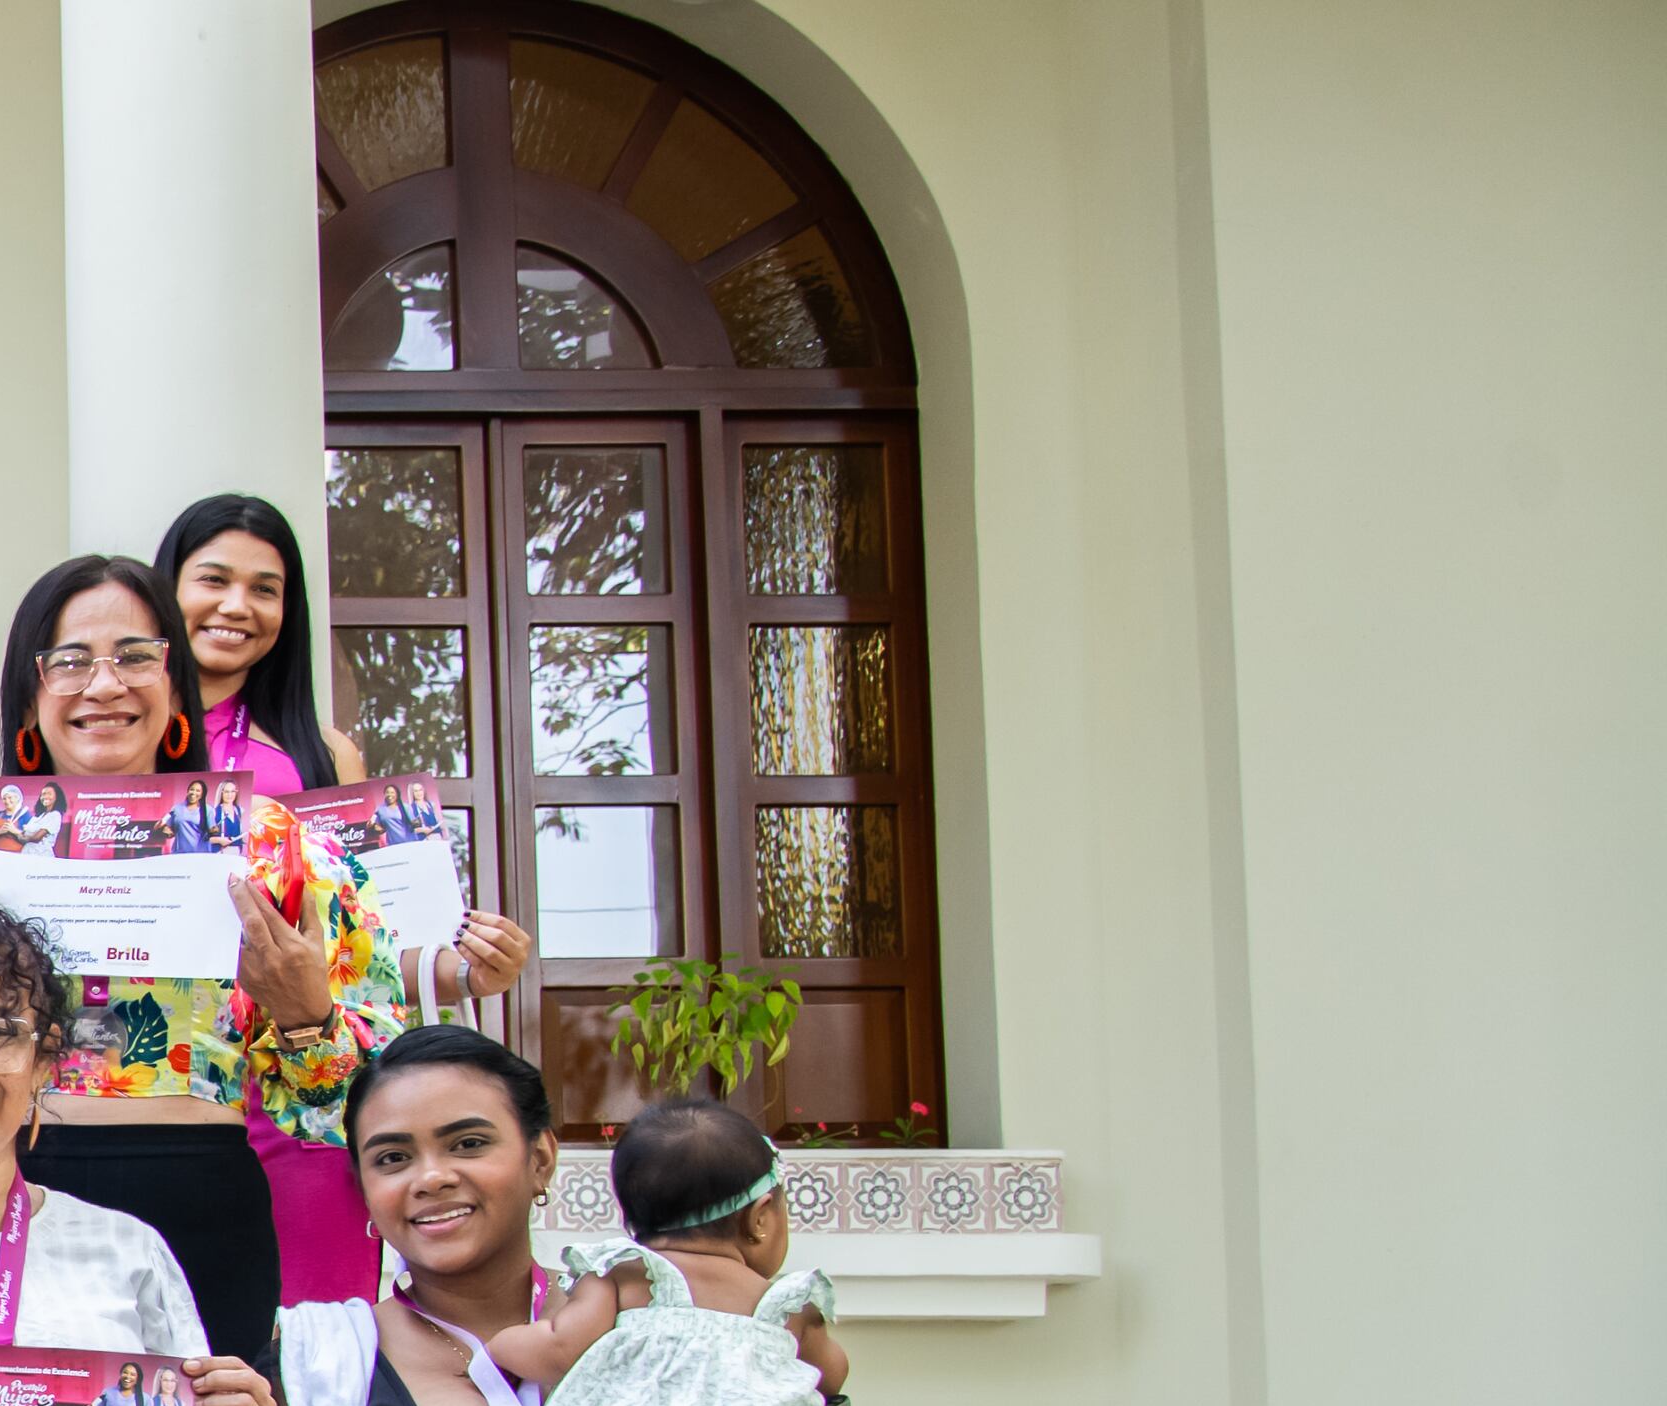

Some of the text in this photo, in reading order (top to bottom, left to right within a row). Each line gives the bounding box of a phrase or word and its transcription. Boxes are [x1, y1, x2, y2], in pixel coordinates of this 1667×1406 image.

[74, 809, 131, 830] Mujeres
[78, 825, 150, 843] Brillantes
[79, 885, 104, 896] Mery
[106, 947, 149, 961] Brilla
[11, 1378, 47, 1393] Premio
